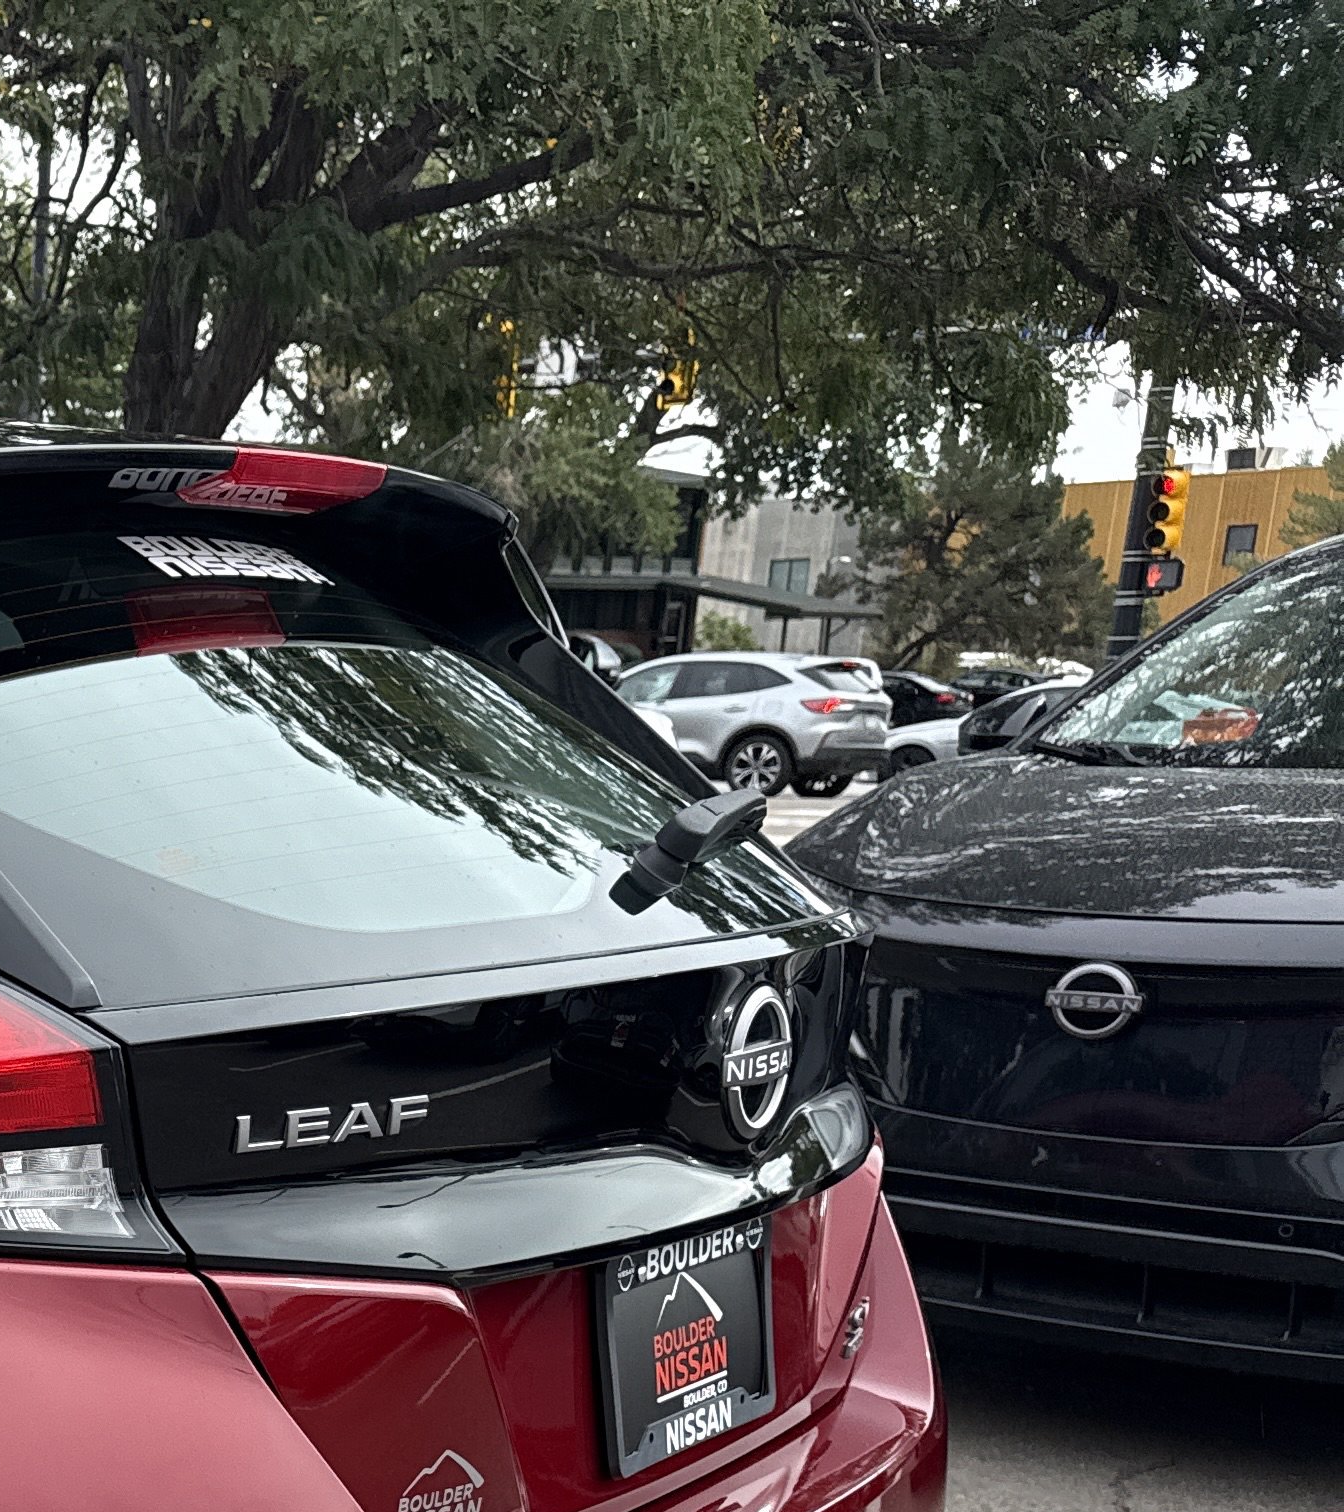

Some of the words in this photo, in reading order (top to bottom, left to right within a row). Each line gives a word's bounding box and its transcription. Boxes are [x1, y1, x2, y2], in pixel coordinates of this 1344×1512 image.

[116, 536, 295, 565] BOULDER
[1048, 994, 1140, 1012] NISSAN
[726, 1049, 789, 1083] NISSA
[235, 1094, 430, 1154] LEAF
[646, 1226, 734, 1280] BOULDER
[653, 1315, 716, 1359] BOULDER
[655, 1336, 728, 1395] NISSAN
[665, 1397, 732, 1454] NISSAN
